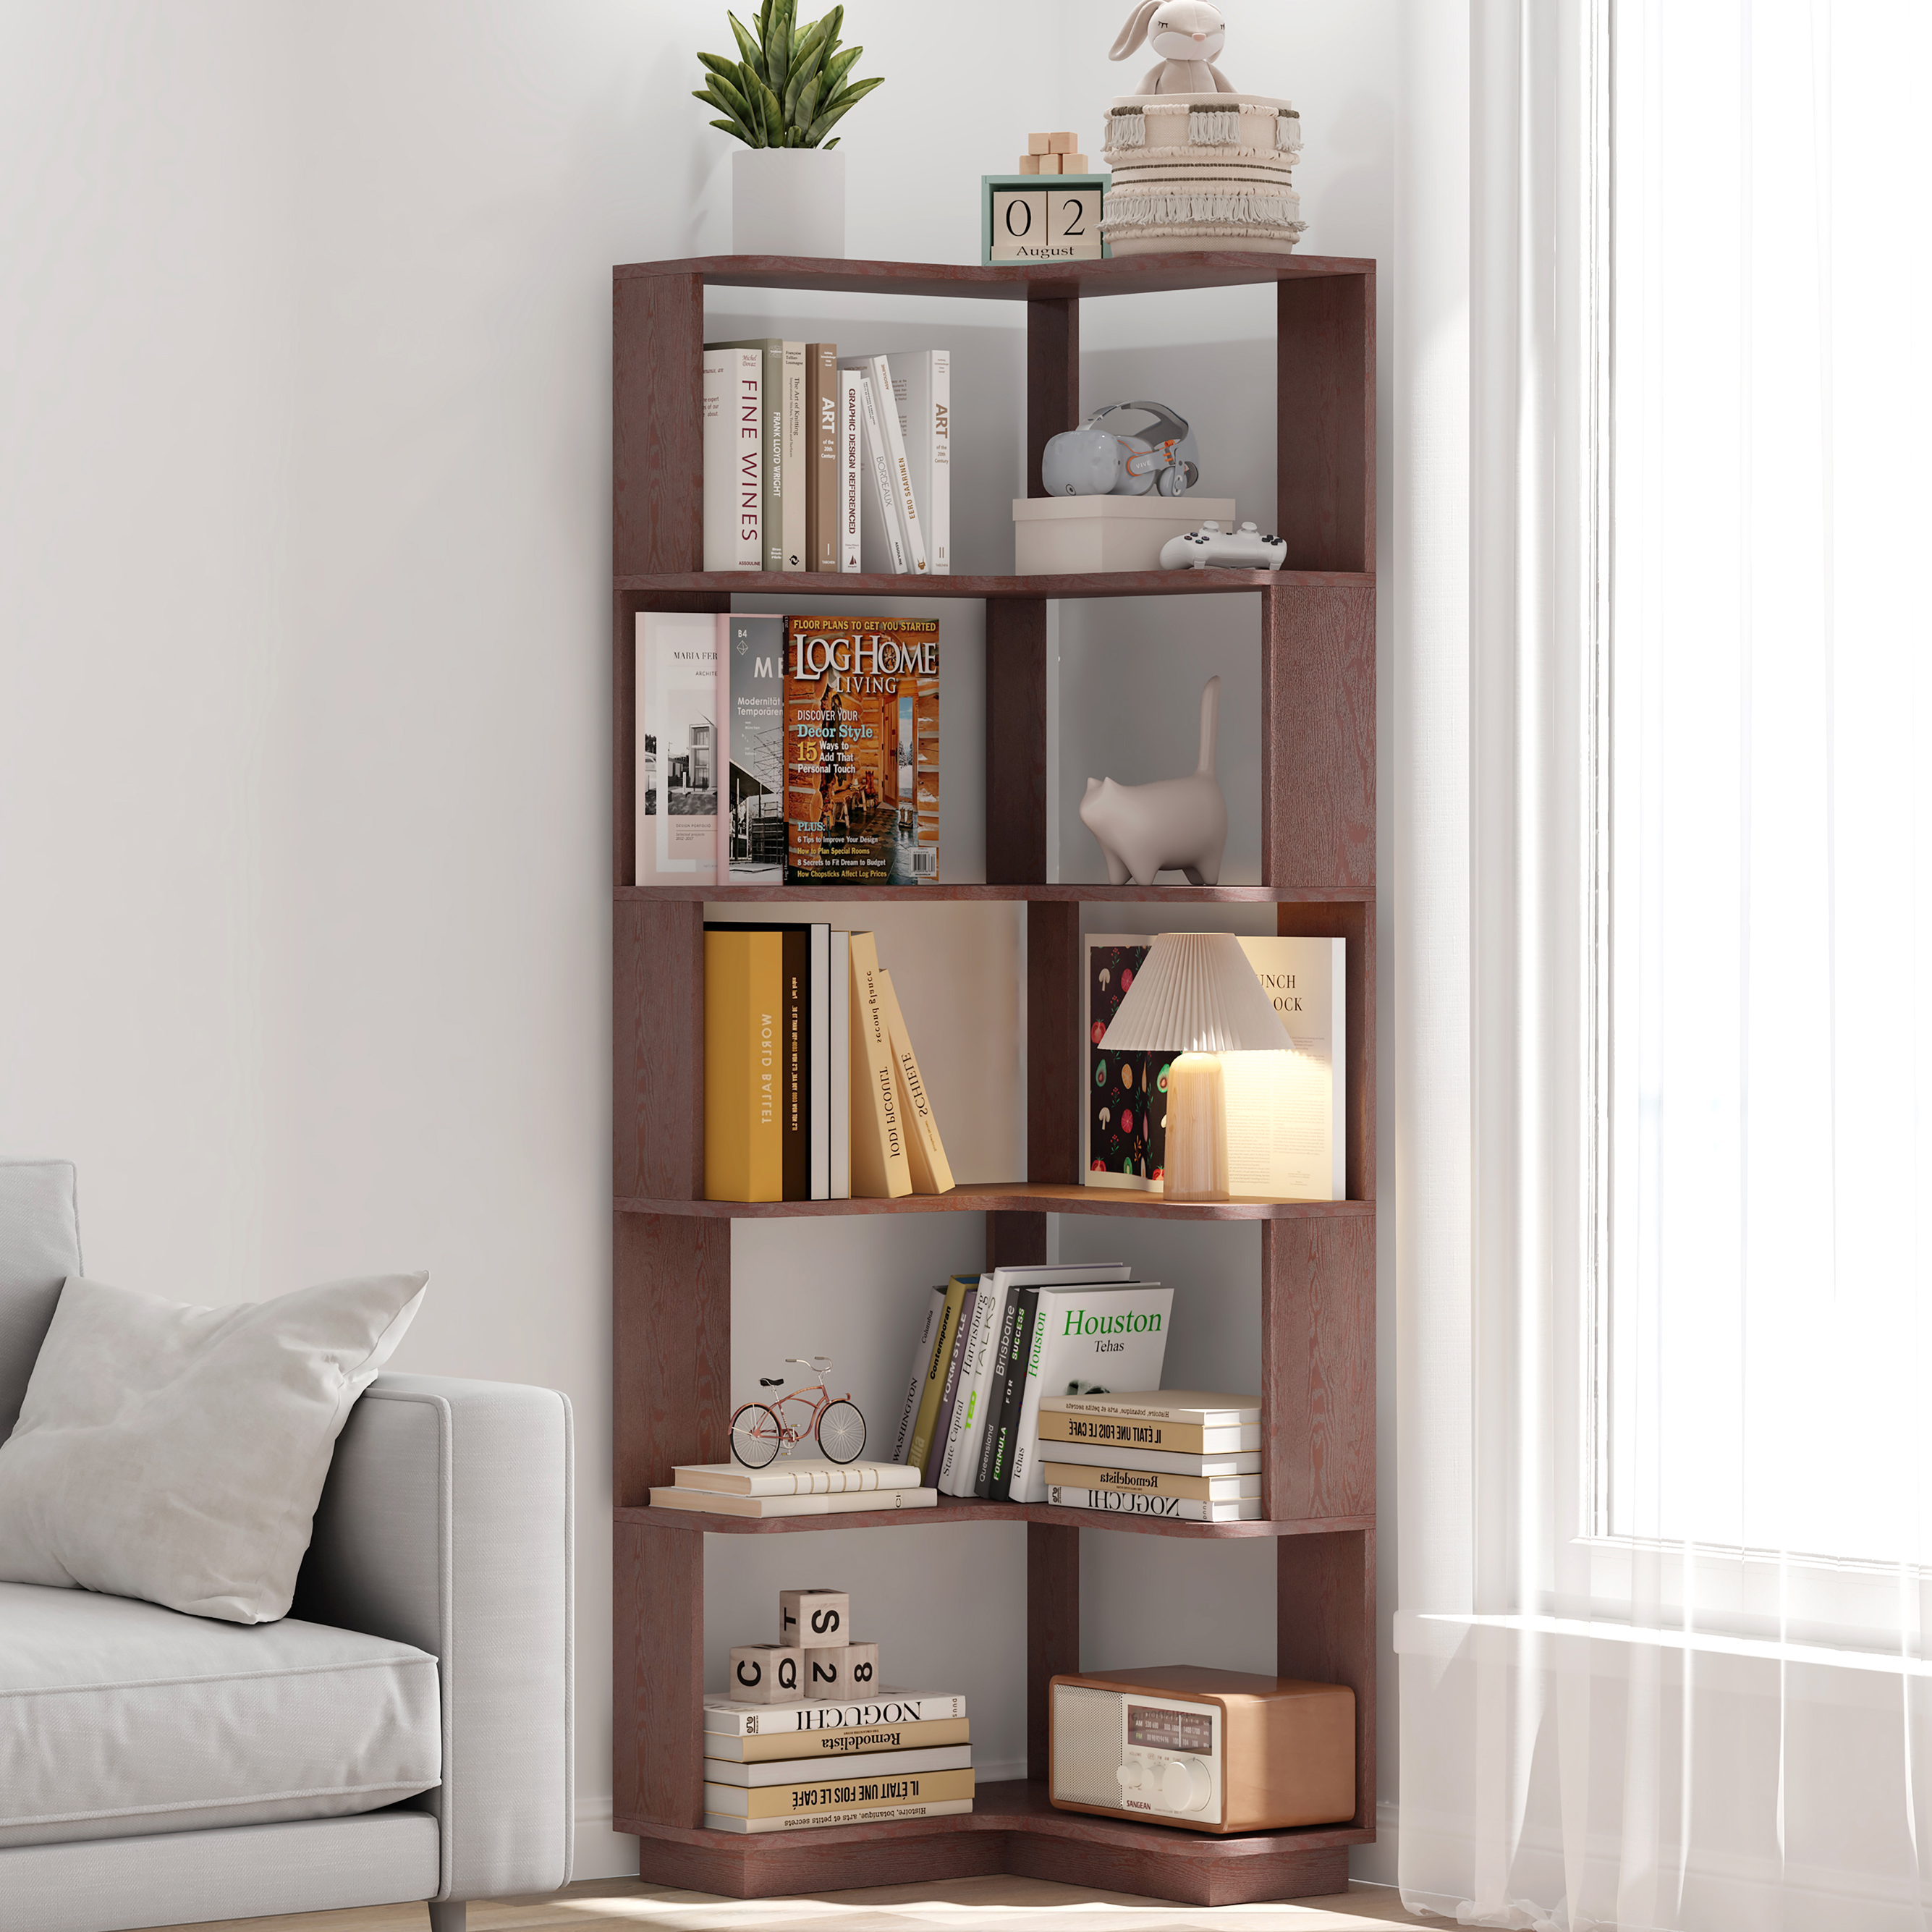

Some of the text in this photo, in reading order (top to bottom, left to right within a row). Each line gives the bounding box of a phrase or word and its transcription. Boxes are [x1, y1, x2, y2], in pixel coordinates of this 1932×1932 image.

[1063, 199, 1085, 235] 2
[1017, 246, 1075, 259] August
[881, 363, 889, 390] ASSOULINE
[822, 397, 835, 433] ART
[936, 403, 948, 439] ART
[742, 380, 757, 540] FINE WINES
[1135, 460, 1151, 469] VIVE
[876, 456, 893, 507] BORDEAUX
[898, 457, 915, 520] EERO SAARINEN
[737, 630, 747, 638] B4
[794, 620, 936, 632] FLOOR PLANS TO GET YOU STARTED
[836, 677, 897, 694] LIVING
[737, 697, 781, 706] Modernität
[737, 707, 784, 717] Temporären
[797, 711, 857, 721] DISCOVER YOUR
[797, 724, 873, 742] Decor Style
[797, 742, 817, 761] 15
[820, 741, 839, 750] Ways
[820, 753, 853, 761] Add That
[798, 764, 855, 773] Personal Touch
[797, 822, 826, 831] PLUS:
[860, 836, 878, 844] Design
[1062, 1309, 1162, 1336] Houston
[930, 1305, 952, 1380] Contemporan
[1094, 1340, 1124, 1353] Tehas
[943, 1313, 967, 1402] FORM STYLE
[965, 1297, 996, 1431] TED TALKS
[892, 1310, 933, 1462] WASHINGTON Columbia
[942, 1292, 988, 1477] State Capital Harrisburg
[979, 1305, 1015, 1482] Queensland Brisbane
[993, 1427, 1007, 1480] FORMULA
[1012, 1308, 1025, 1360] SUCCESS
[1014, 1312, 1046, 1478] Tehas Houston
[811, 1609, 840, 1634] S
[737, 1660, 762, 1687] C
[778, 1658, 797, 1690] Q
[813, 1661, 837, 1683] 2
[854, 1662, 873, 1682] 8
[796, 1701, 922, 1731] NOGUCHI
[821, 1732, 901, 1751] Remodelista
[792, 1780, 920, 1810] IL ÉTAIT UNE FOIS LE CAFÉ
[1127, 1800, 1151, 1810] SANGEAN
[812, 1815, 832, 1824] petits
[859, 1809, 895, 1820] botanique,
[896, 1807, 926, 1816] Histoire,
